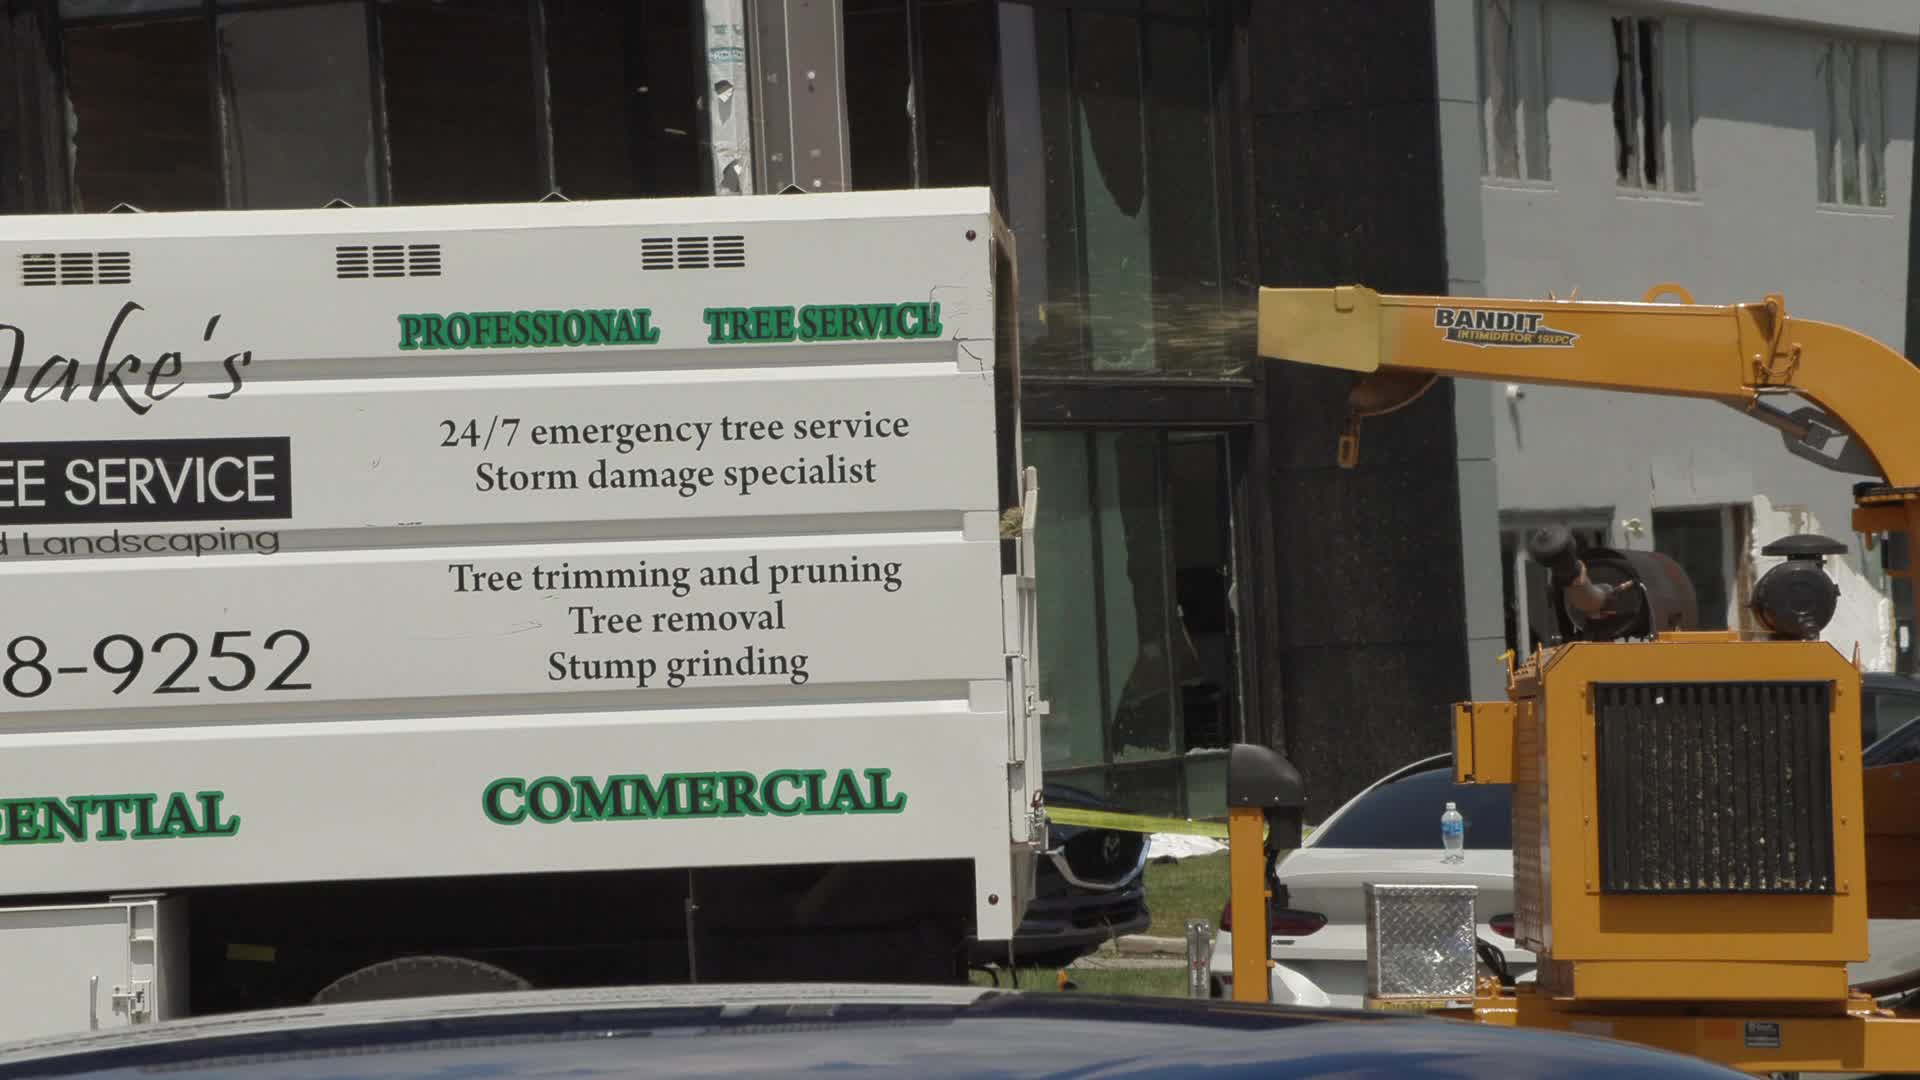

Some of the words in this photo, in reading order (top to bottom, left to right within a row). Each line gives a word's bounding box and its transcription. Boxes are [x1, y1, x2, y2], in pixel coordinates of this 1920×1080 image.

[400, 307, 660, 350] PROFESSIONAL
[703, 306, 796, 344] TREE
[799, 302, 943, 342] SERVICE
[1436, 308, 1542, 332] BANDIT
[439, 415, 521, 450] 24/7
[530, 421, 713, 455] emergency
[721, 416, 784, 442] tree
[793, 410, 910, 440] service
[64, 455, 275, 506] SERVICE
[475, 461, 579, 493] Storm
[587, 459, 715, 497] damage
[723, 454, 876, 497] specialist
[23, 526, 280, 557] Landscaping
[448, 564, 523, 593] Tree
[532, 560, 691, 598] trimming
[699, 555, 761, 587] and
[768, 555, 903, 595] pruning
[568, 605, 643, 635] Tree
[652, 600, 786, 634] removal
[2, 629, 312, 698] 8-9252
[547, 650, 657, 689] Stump
[666, 646, 810, 689] grinding
[0, 791, 241, 845] ENTIAL
[482, 768, 907, 825] COMMERCIAL
